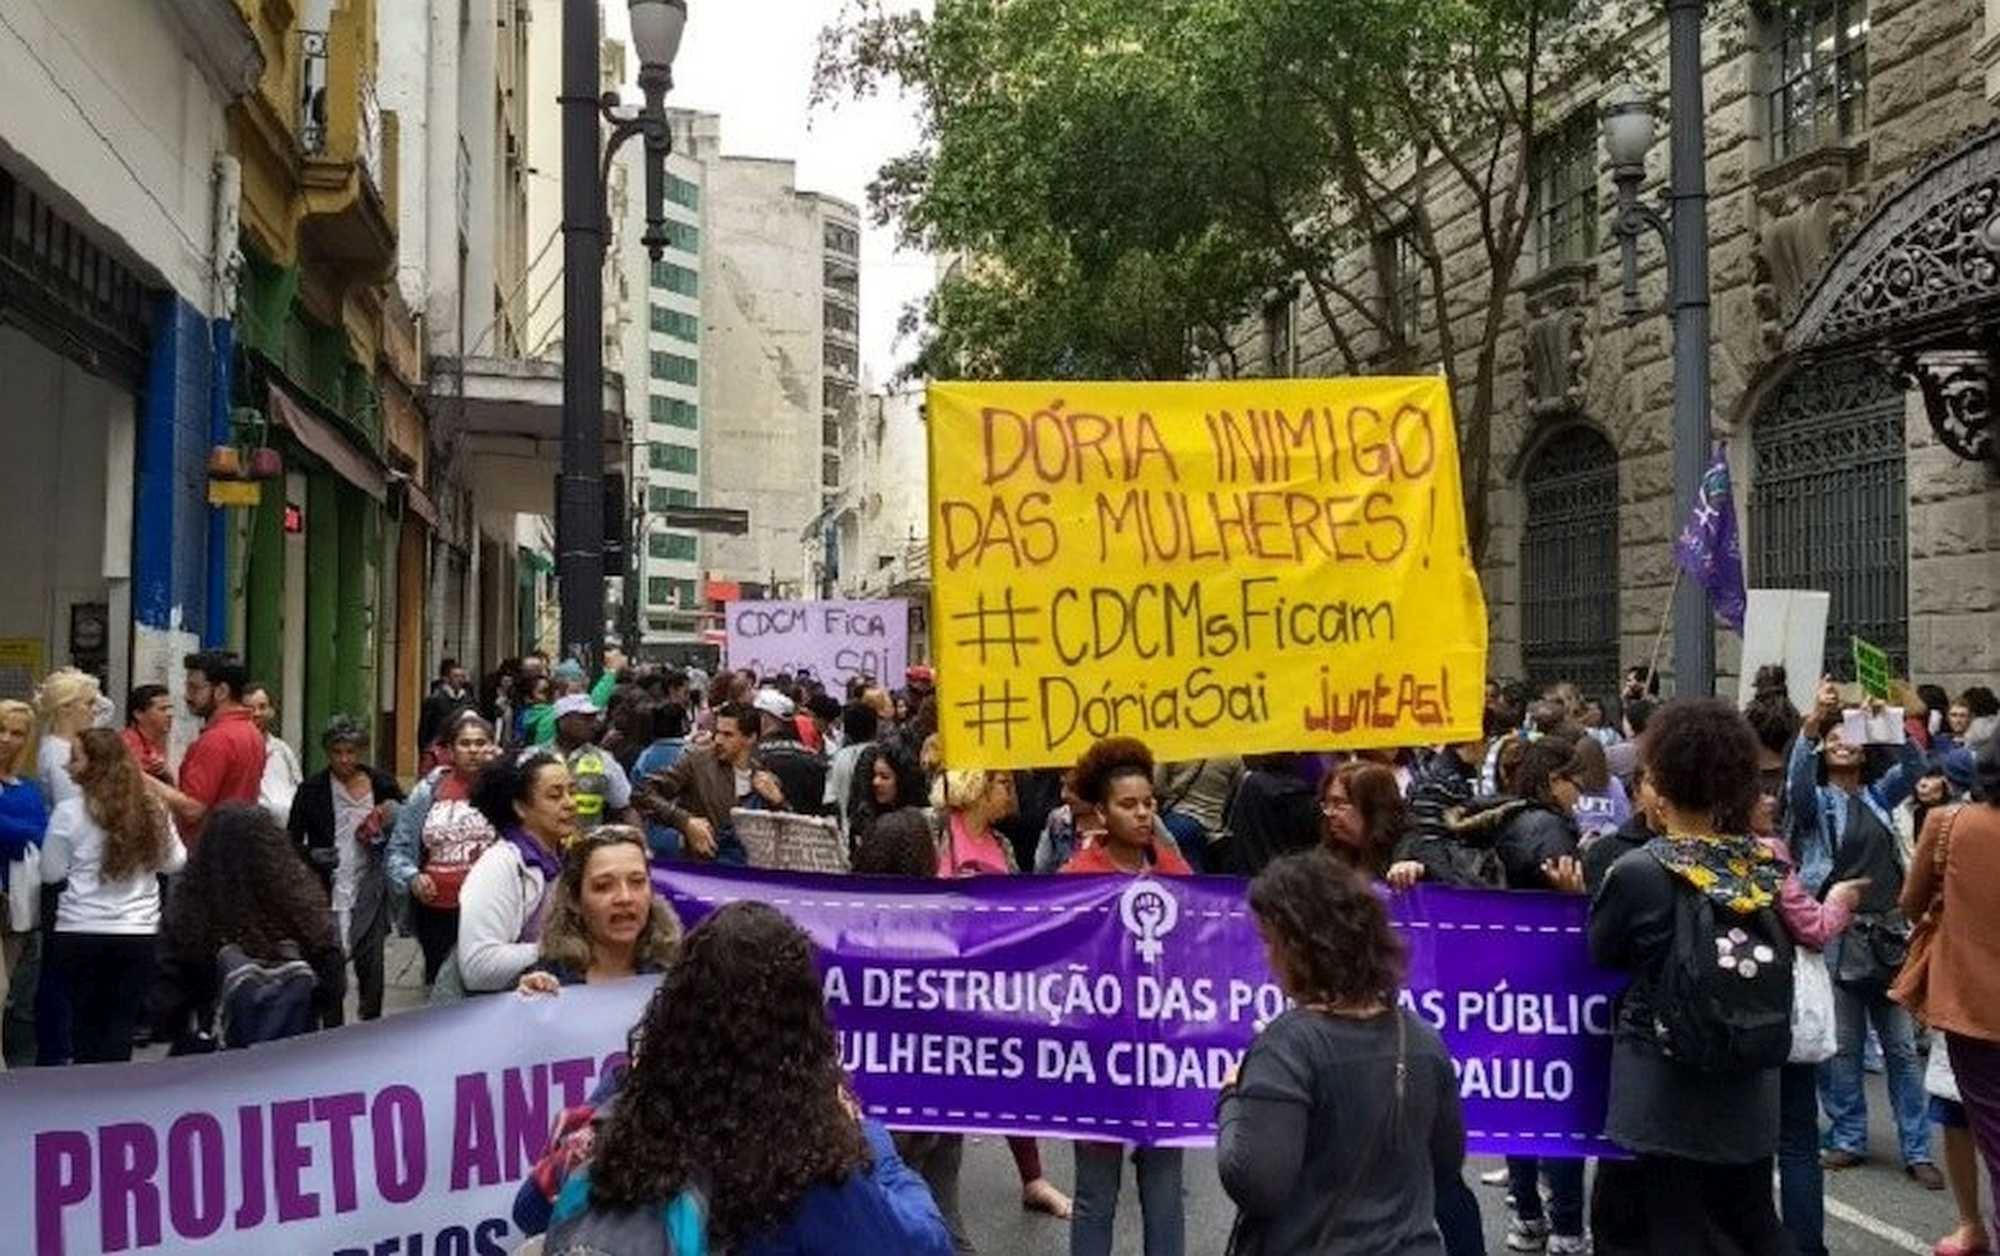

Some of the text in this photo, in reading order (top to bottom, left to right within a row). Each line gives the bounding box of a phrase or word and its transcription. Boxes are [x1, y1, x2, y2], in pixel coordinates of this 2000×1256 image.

[981, 399, 1436, 486] DÓRIA INIMIGO
[940, 491, 1059, 571] DAS
[736, 608, 808, 638] CDCM
[956, 667, 1269, 753] #DóriaSai
[863, 964, 1122, 1027] DESTRUIÇÃO
[1137, 976, 1217, 1021] DAS
[834, 1029, 1574, 1101] ULHERES DA CIDAD AULO
[34, 1051, 633, 1256] PROJETO ANT
